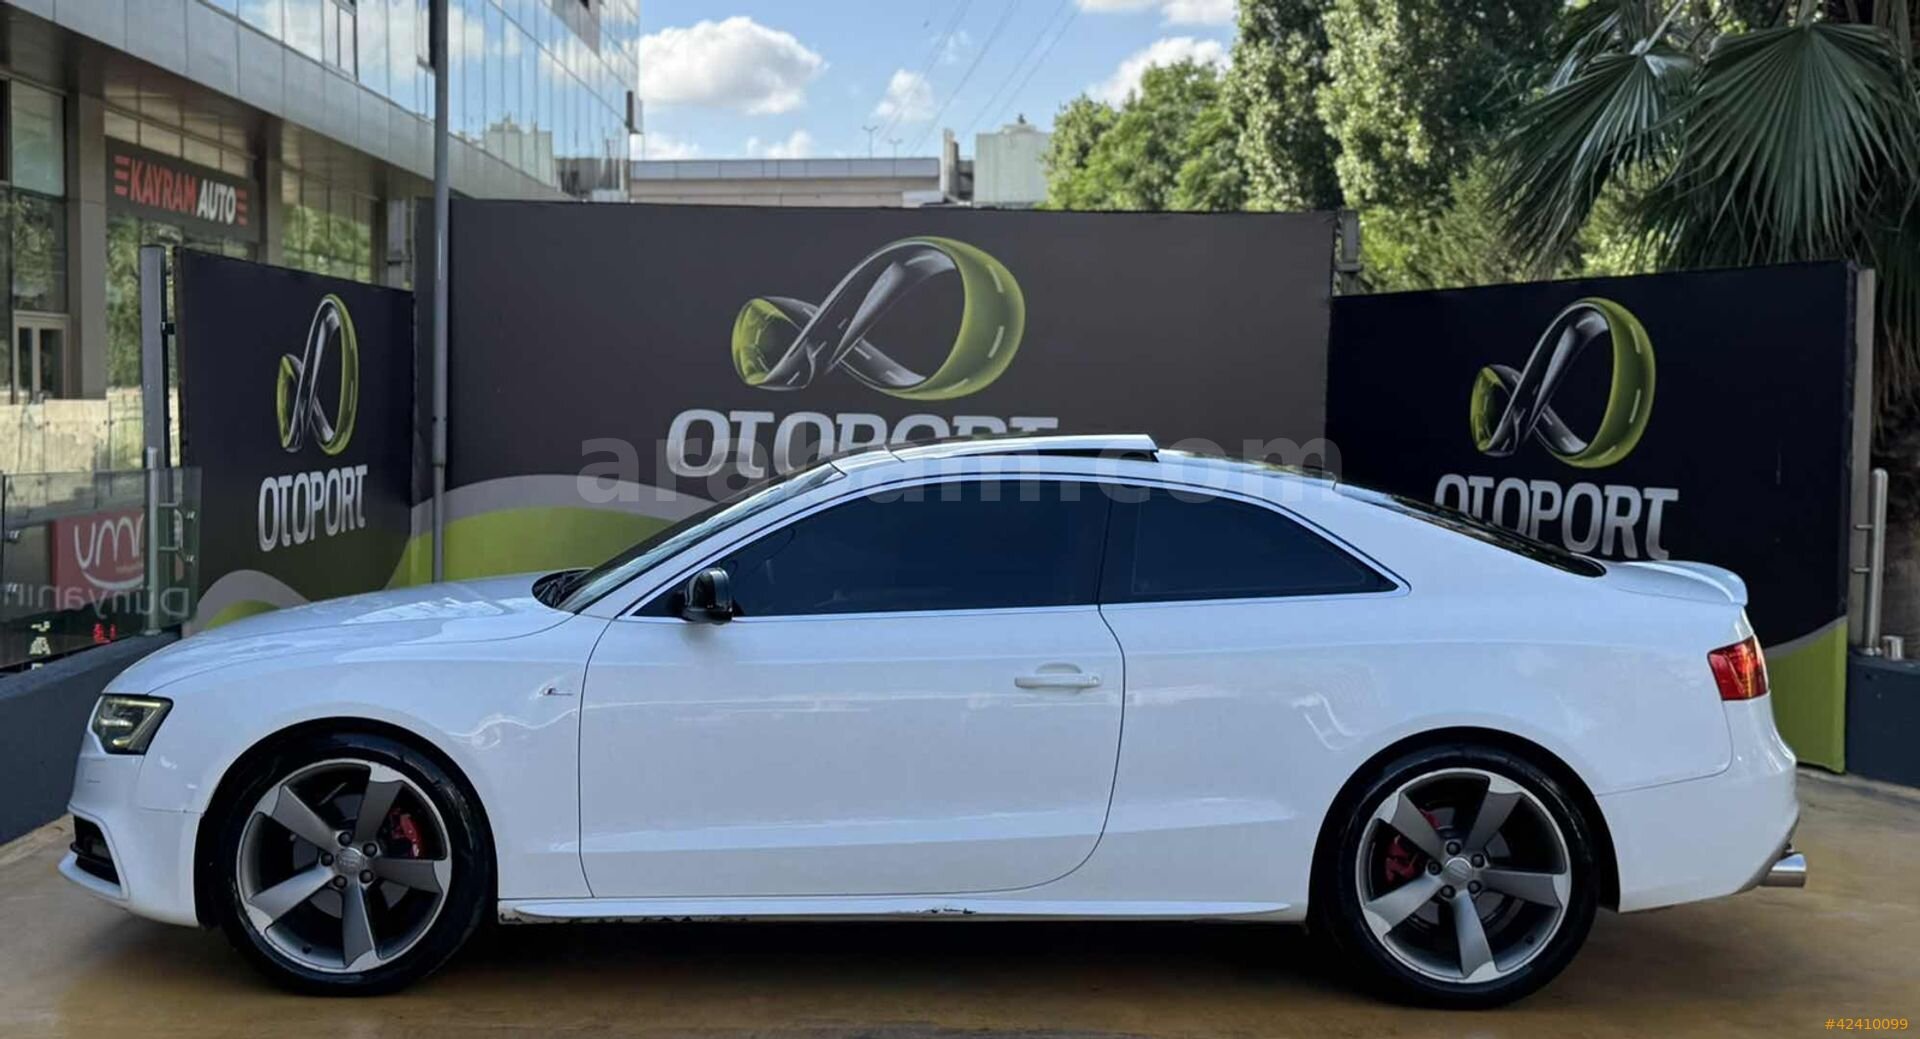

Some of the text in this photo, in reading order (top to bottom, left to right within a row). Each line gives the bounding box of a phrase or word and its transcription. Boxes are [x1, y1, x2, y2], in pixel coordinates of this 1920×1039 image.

[130, 158, 237, 224] KAYRAM AUTO
[666, 408, 1059, 478] OTOP
[258, 464, 368, 552] OTOPORT
